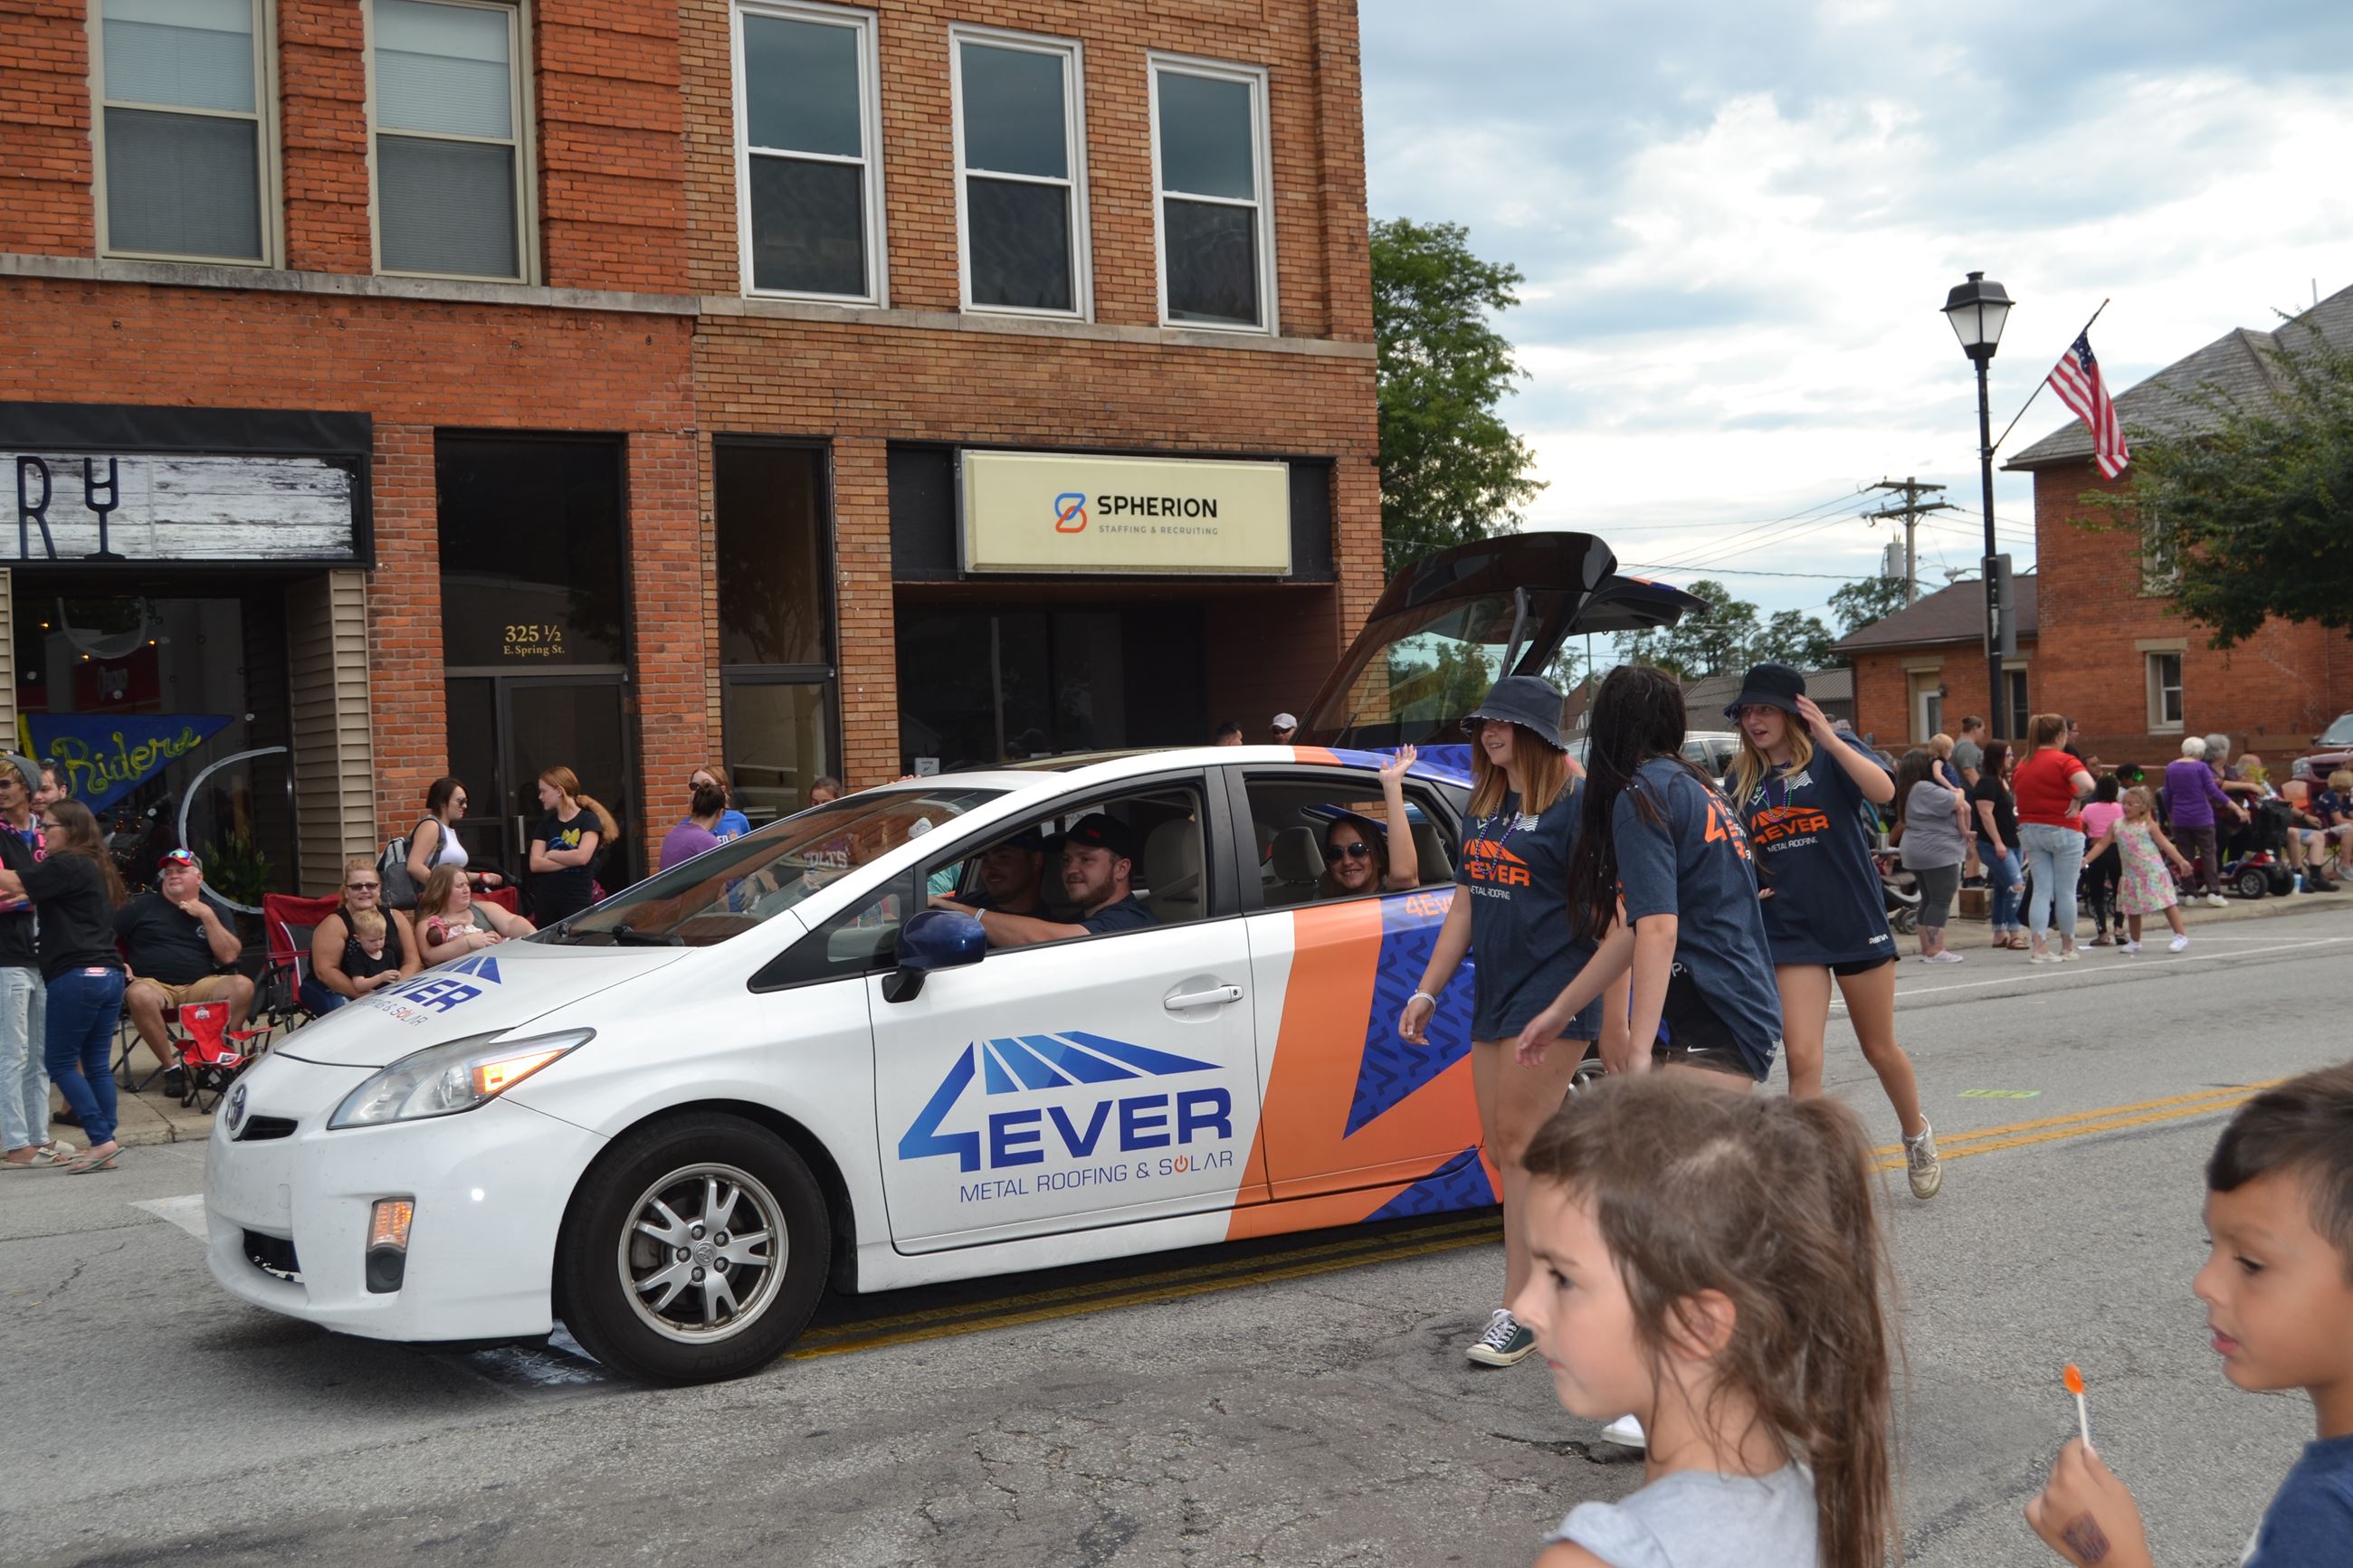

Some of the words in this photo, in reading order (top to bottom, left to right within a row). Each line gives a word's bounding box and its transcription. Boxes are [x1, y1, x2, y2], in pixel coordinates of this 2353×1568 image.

[1097, 495, 1217, 518] SPHERION
[1099, 525, 1147, 534] STAFFING
[1161, 527, 1218, 536] RECRUITING
[505, 625, 539, 642] 325
[503, 645, 514, 655] E.
[515, 644, 550, 657] Spring
[551, 644, 565, 654] St.
[898, 1040, 1233, 1174] 4EVER
[959, 1180, 1029, 1203] METAL
[1037, 1164, 1128, 1193] ROOFING
[1136, 1162, 1150, 1179] &
[1158, 1150, 1233, 1176] SOLAR
